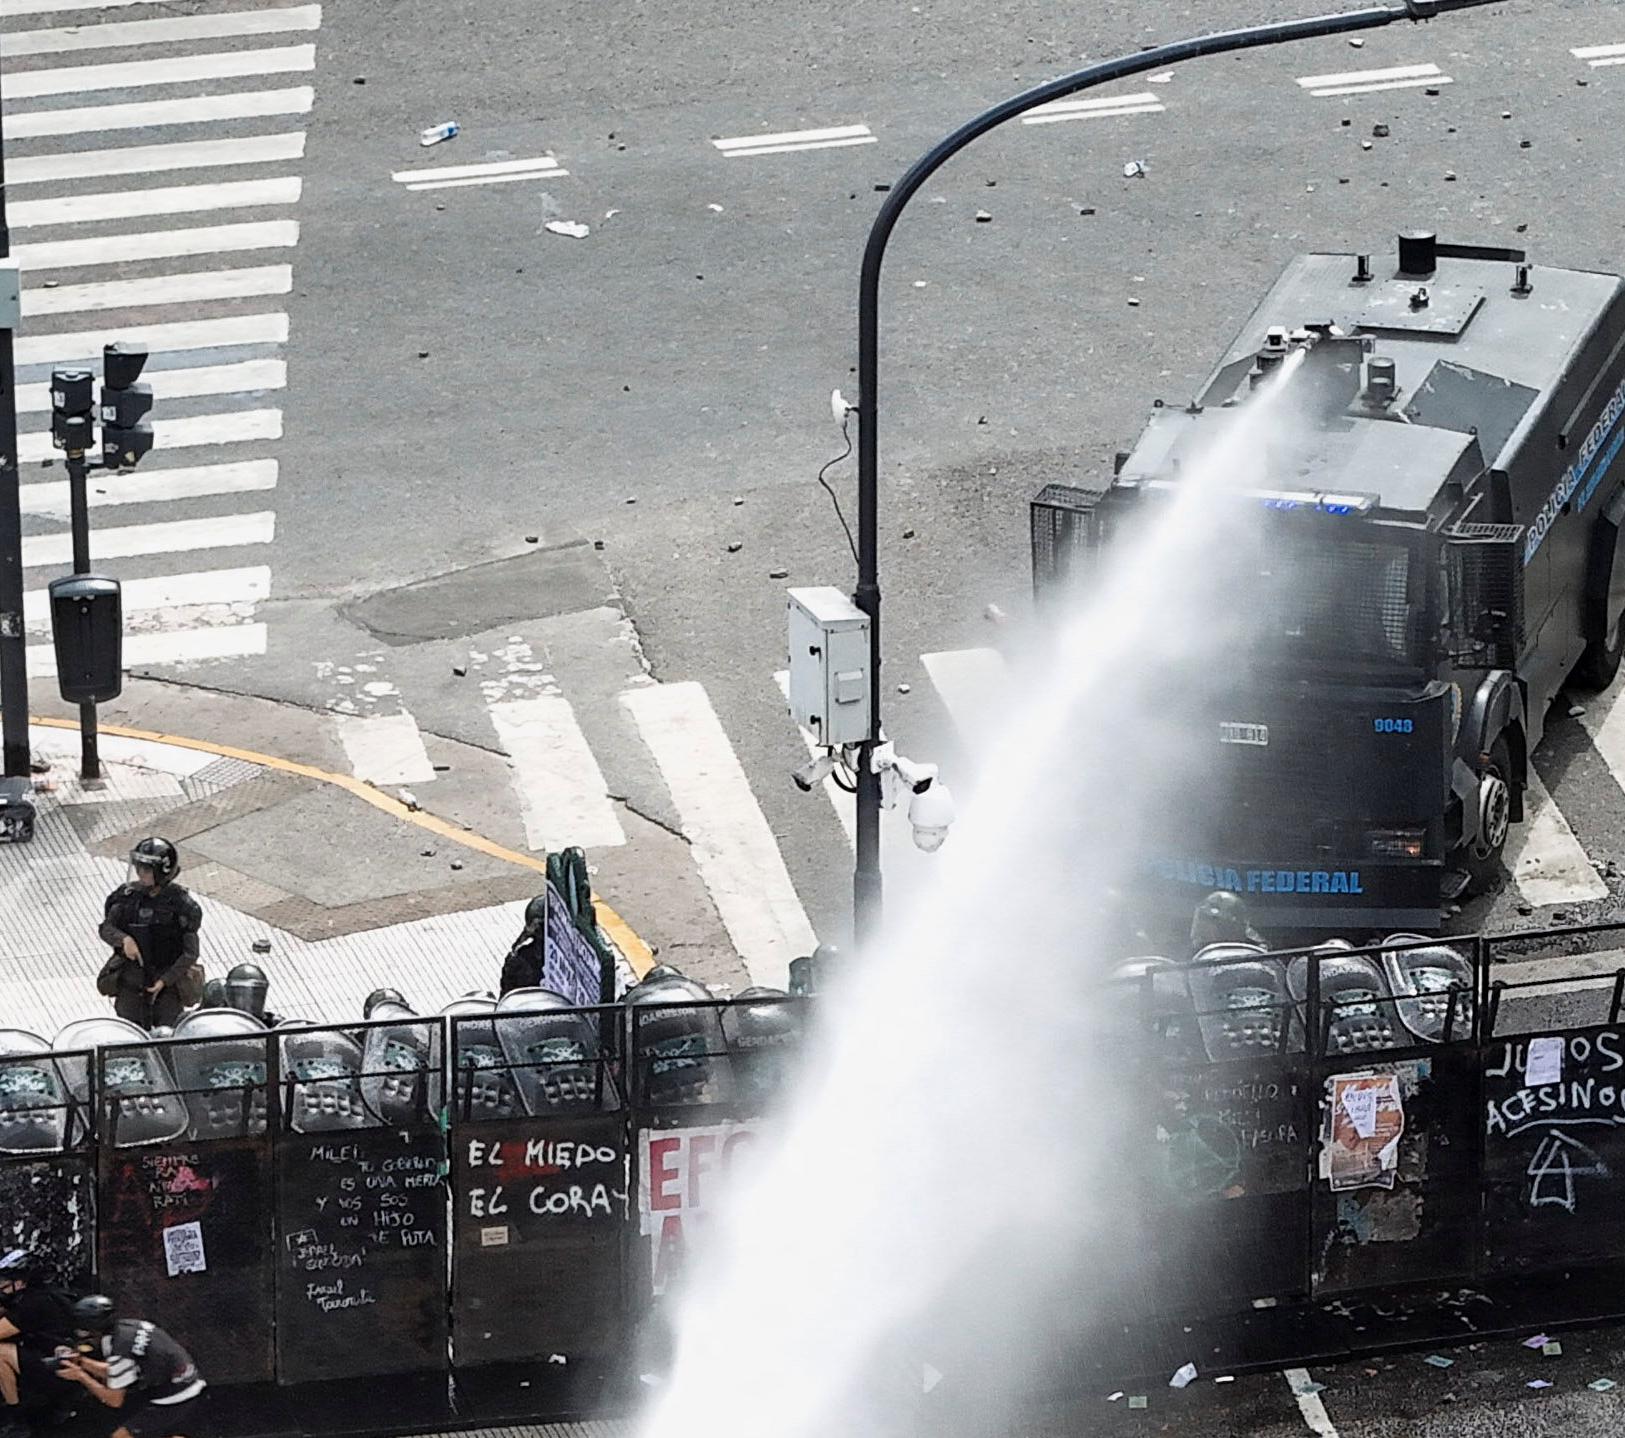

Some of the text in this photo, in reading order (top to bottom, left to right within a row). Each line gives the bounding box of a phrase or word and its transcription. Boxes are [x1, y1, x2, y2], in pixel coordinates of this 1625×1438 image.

[1246, 870, 1363, 894] FEDERAL
[468, 1137, 617, 1170] EL MIEDO
[468, 1185, 509, 1219] EL
